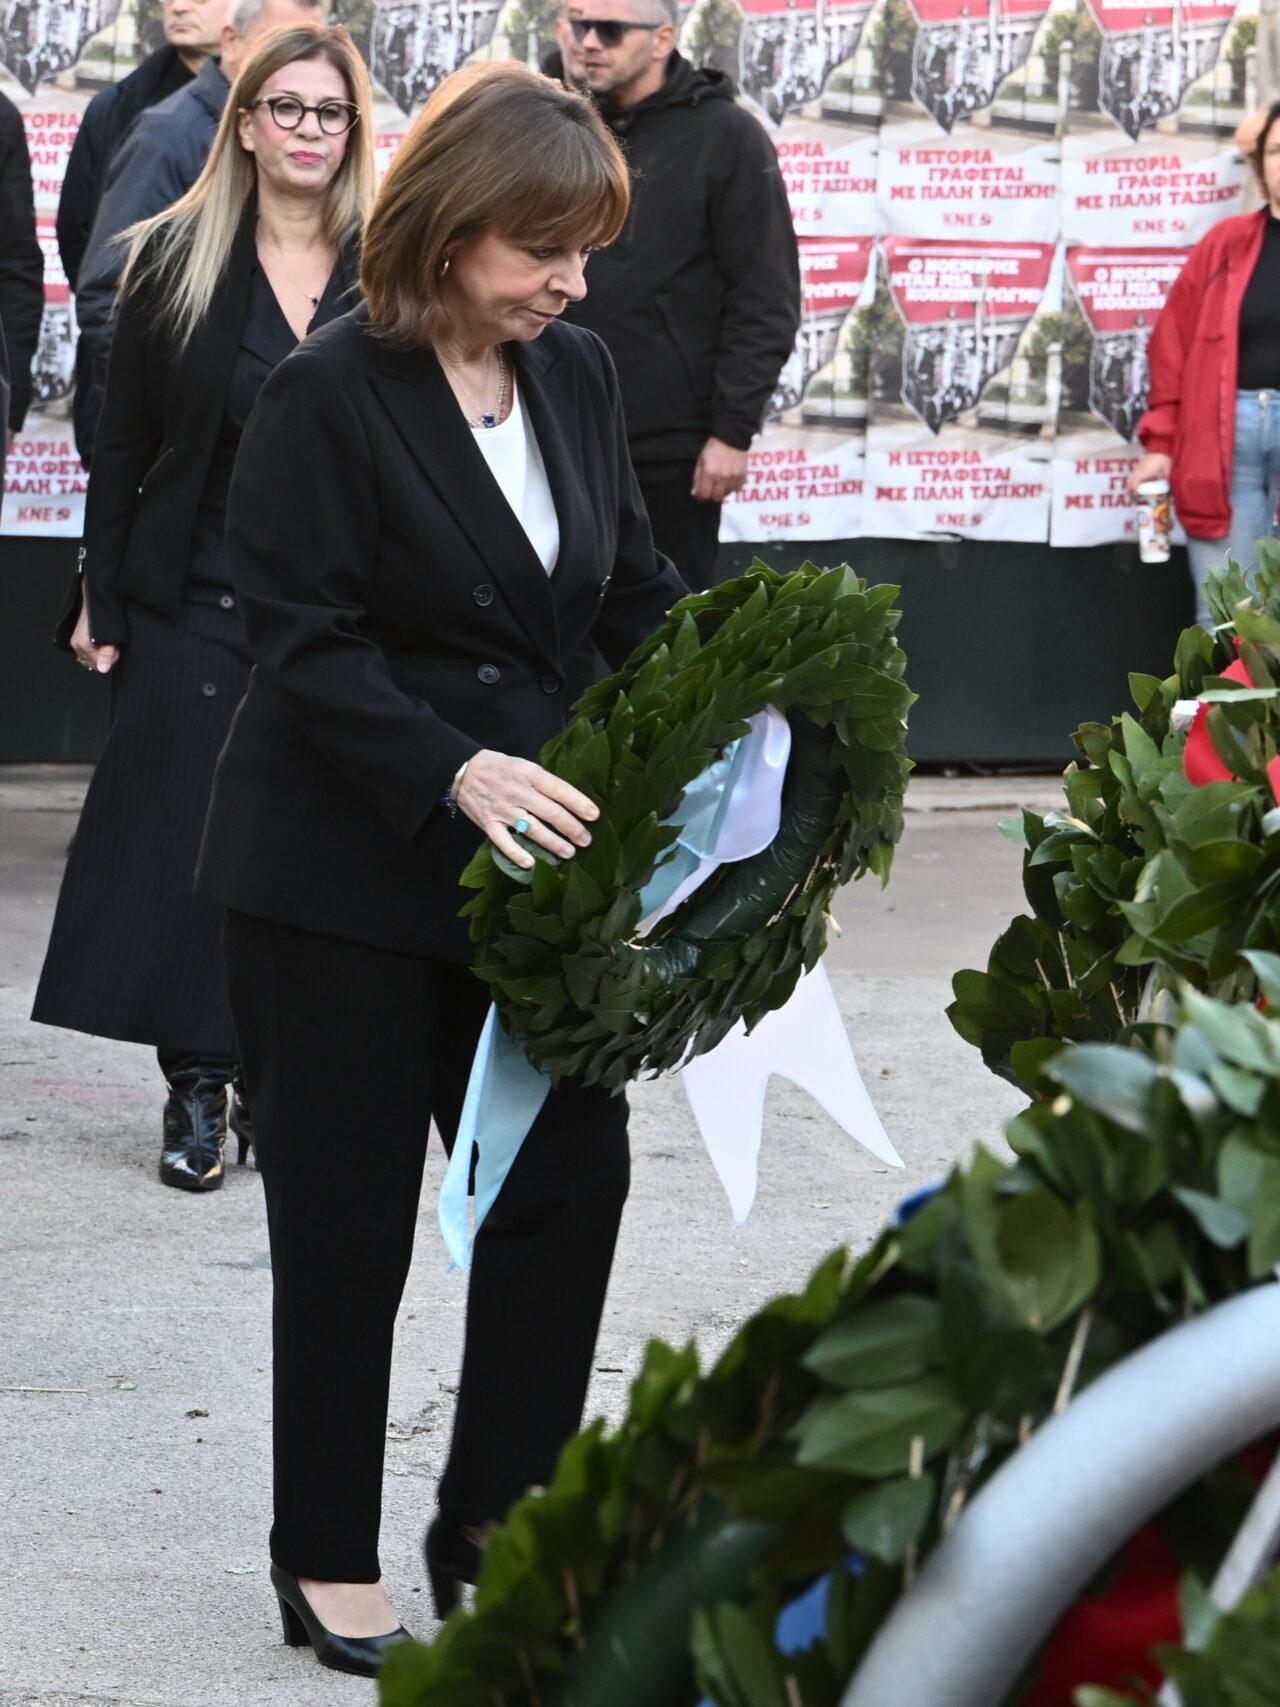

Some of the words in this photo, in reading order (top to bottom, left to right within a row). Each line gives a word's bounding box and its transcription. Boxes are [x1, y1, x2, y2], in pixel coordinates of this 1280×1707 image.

[916, 149, 993, 165] ΙΣΤΟΡΙΑ
[1103, 156, 1183, 174] ΙΣΤΟΡΙΑ
[928, 167, 1025, 182] ΓΡΑΦΕΤΑΙ
[1117, 172, 1217, 191] ΓΡΑΦΕΤΑΙ
[921, 185, 974, 200] ΠΑΛΗ
[1109, 193, 1162, 209] ΠΑΛΗ
[907, 449, 982, 465] ΙΣΤΟΡΙΑ
[921, 467, 1010, 482] ΓΡΑΦΕΤΑΙ
[913, 486, 964, 501] ΠΑΛΗ
